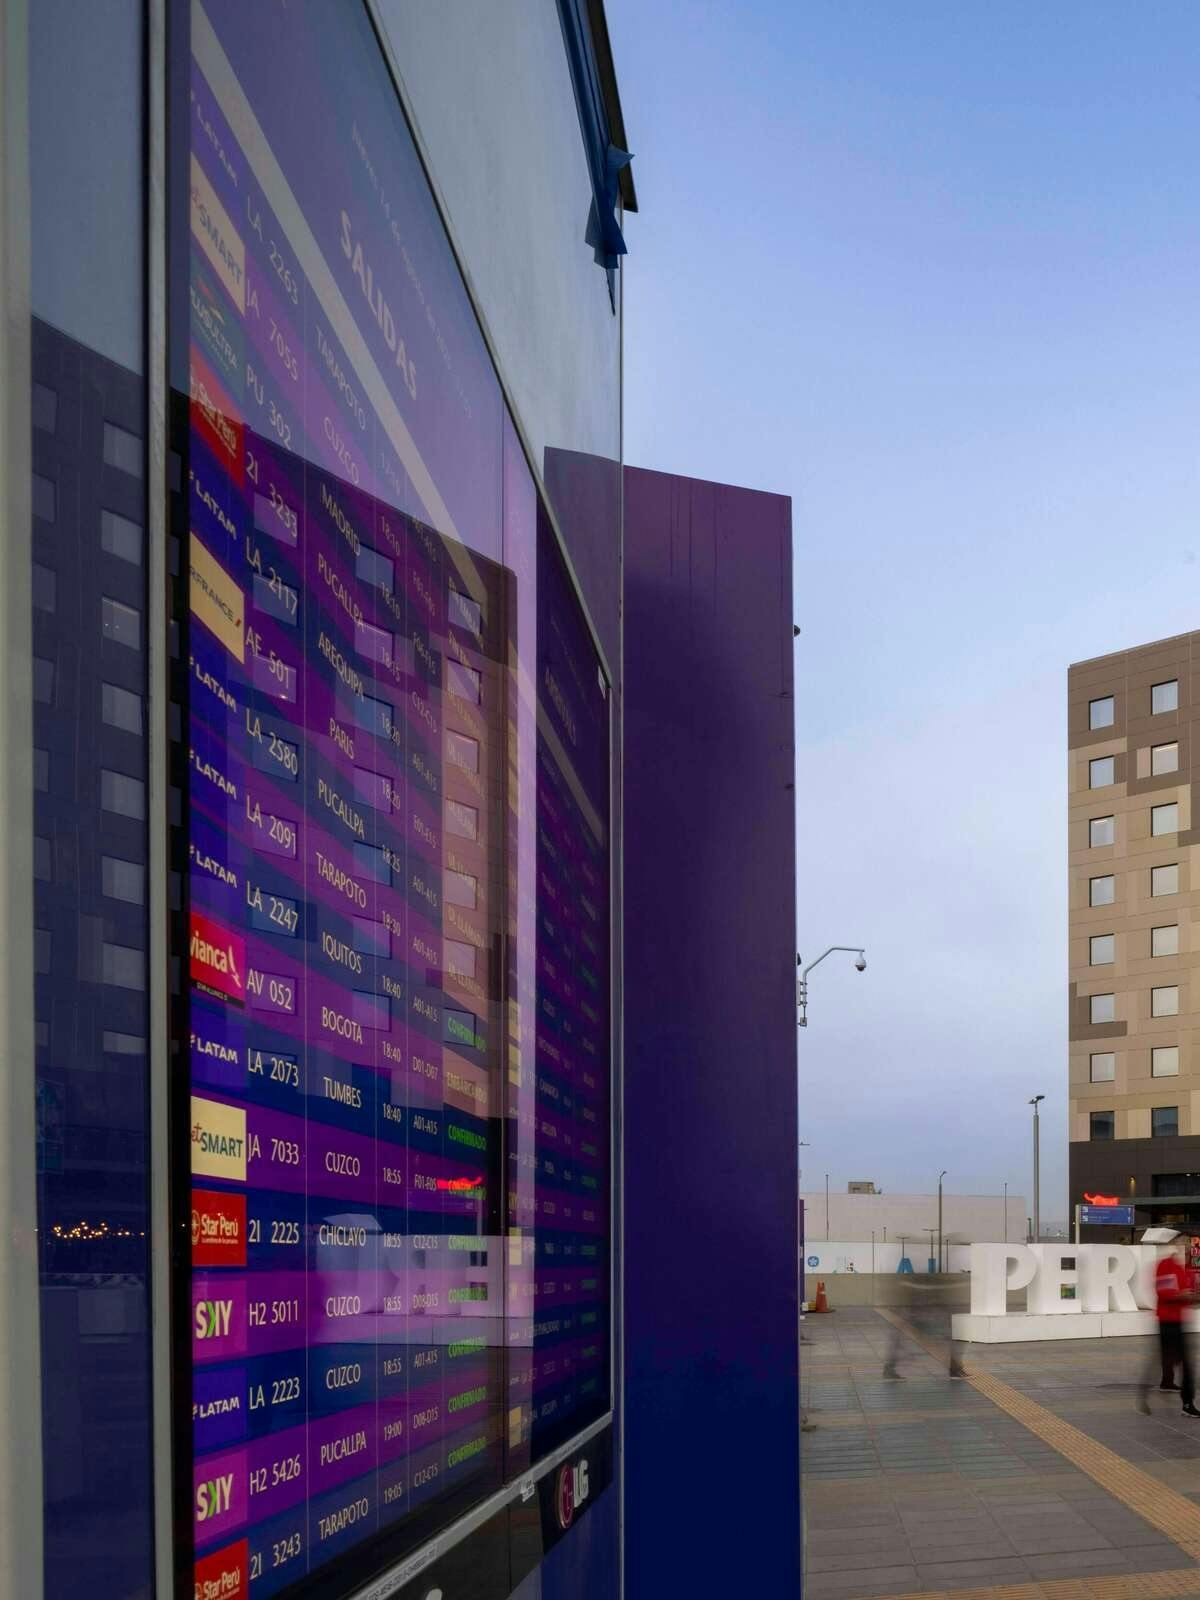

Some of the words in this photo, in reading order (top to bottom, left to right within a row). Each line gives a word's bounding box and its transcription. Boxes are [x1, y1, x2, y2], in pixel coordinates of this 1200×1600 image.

[247, 194, 263, 245] LA
[315, 323, 367, 432] TARAPOTO
[340, 208, 417, 402] SALIDAS
[246, 278, 261, 320] JA
[270, 314, 298, 382] 7055
[324, 416, 360, 487] CUZCO
[246, 364, 264, 408] PU
[269, 400, 293, 451] 302
[320, 484, 360, 557] MADRID
[196, 480, 238, 540] LATAM
[269, 483, 298, 538] 3233
[318, 553, 365, 633] PUCALLPA
[246, 536, 262, 577] LA
[318, 632, 365, 702] AREQUIPA
[196, 664, 238, 713] LATAM
[268, 650, 289, 690] 501
[330, 717, 356, 761] PARIS
[196, 758, 238, 801] LATAM
[246, 707, 263, 745] LA
[268, 731, 298, 777] 2580
[318, 777, 365, 840] PUCALLPA
[196, 851, 238, 889] LATAM
[246, 794, 263, 832] LA
[268, 815, 297, 859] 2091
[316, 851, 367, 909] TARAPOTO
[382, 908, 400, 938] 18:30
[246, 881, 263, 913] LA
[269, 892, 299, 931] 2247
[322, 931, 362, 975] IQUITOS
[382, 973, 401, 1000] 18:40
[197, 1036, 239, 1065] LATAM
[246, 968, 265, 996] AV
[269, 979, 293, 1011] 052
[322, 1005, 364, 1045] BOGOTA
[382, 1040, 401, 1064] 18:40
[247, 1047, 264, 1076] LA
[270, 1056, 299, 1088] 2073
[323, 1076, 362, 1109] TUMBES
[382, 1102, 402, 1125] 18:40
[247, 1132, 262, 1163] JA
[271, 1138, 300, 1165] 7033
[325, 1151, 361, 1178] CUZCO
[383, 1166, 402, 1185] 18:55
[201, 1212, 219, 1236] Star
[219, 1215, 239, 1237] Perú
[271, 1220, 300, 1245] 2225
[319, 1224, 367, 1248] CHICLAYO
[383, 1233, 402, 1249] 18:55
[249, 1305, 267, 1327] H2
[271, 1300, 300, 1325] 5011
[325, 1296, 361, 1318] CUZCO
[383, 1295, 402, 1312] 18:55
[199, 1396, 240, 1419] LATAM
[249, 1383, 266, 1411] LA
[271, 1376, 301, 1405] 2223
[325, 1363, 362, 1390] CUZCO
[383, 1355, 402, 1376] 18:55
[250, 1469, 268, 1496] H2
[271, 1453, 301, 1487] 5426
[320, 1430, 367, 1466] PUCALLPA
[384, 1420, 403, 1442] 19:00
[573, 1459, 590, 1509] LG
[272, 1532, 301, 1568] 3243
[318, 1497, 369, 1541] TARAPOTO
[384, 1481, 404, 1505] 19:05
[203, 1576, 223, 1600] Star
[221, 1566, 241, 1591] Perú
